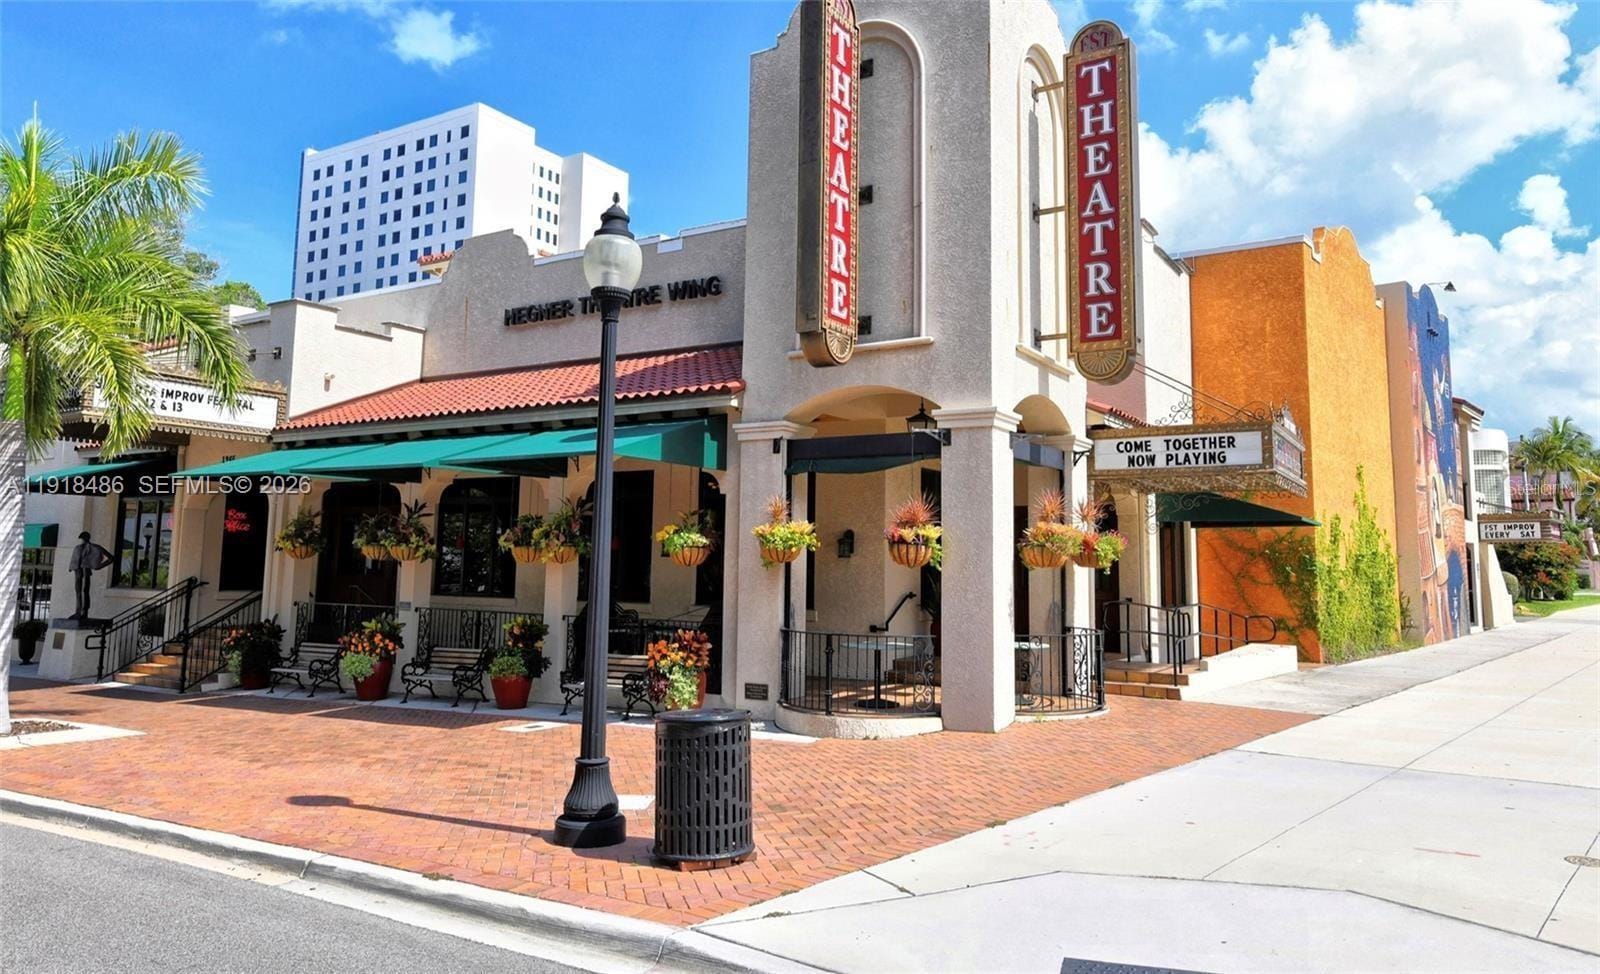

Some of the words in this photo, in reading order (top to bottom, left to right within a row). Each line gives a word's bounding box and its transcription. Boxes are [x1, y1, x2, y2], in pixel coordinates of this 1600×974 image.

[830, 21, 852, 321] THEATRE
[1080, 60, 1117, 339] THEATRE
[504, 299, 576, 326] HEGNER
[577, 284, 662, 314] THTRE
[667, 276, 722, 302] WING
[160, 387, 205, 404] IMPROV
[160, 400, 168, 411] &
[172, 402, 183, 413] 13
[1116, 440, 1152, 453] COME
[1164, 436, 1236, 451] TOGETHER
[1127, 454, 1156, 467] NOW
[1165, 451, 1227, 466] PLAYING
[1485, 531, 1510, 539] EVERY
[1503, 523, 1535, 531] IMPROV
